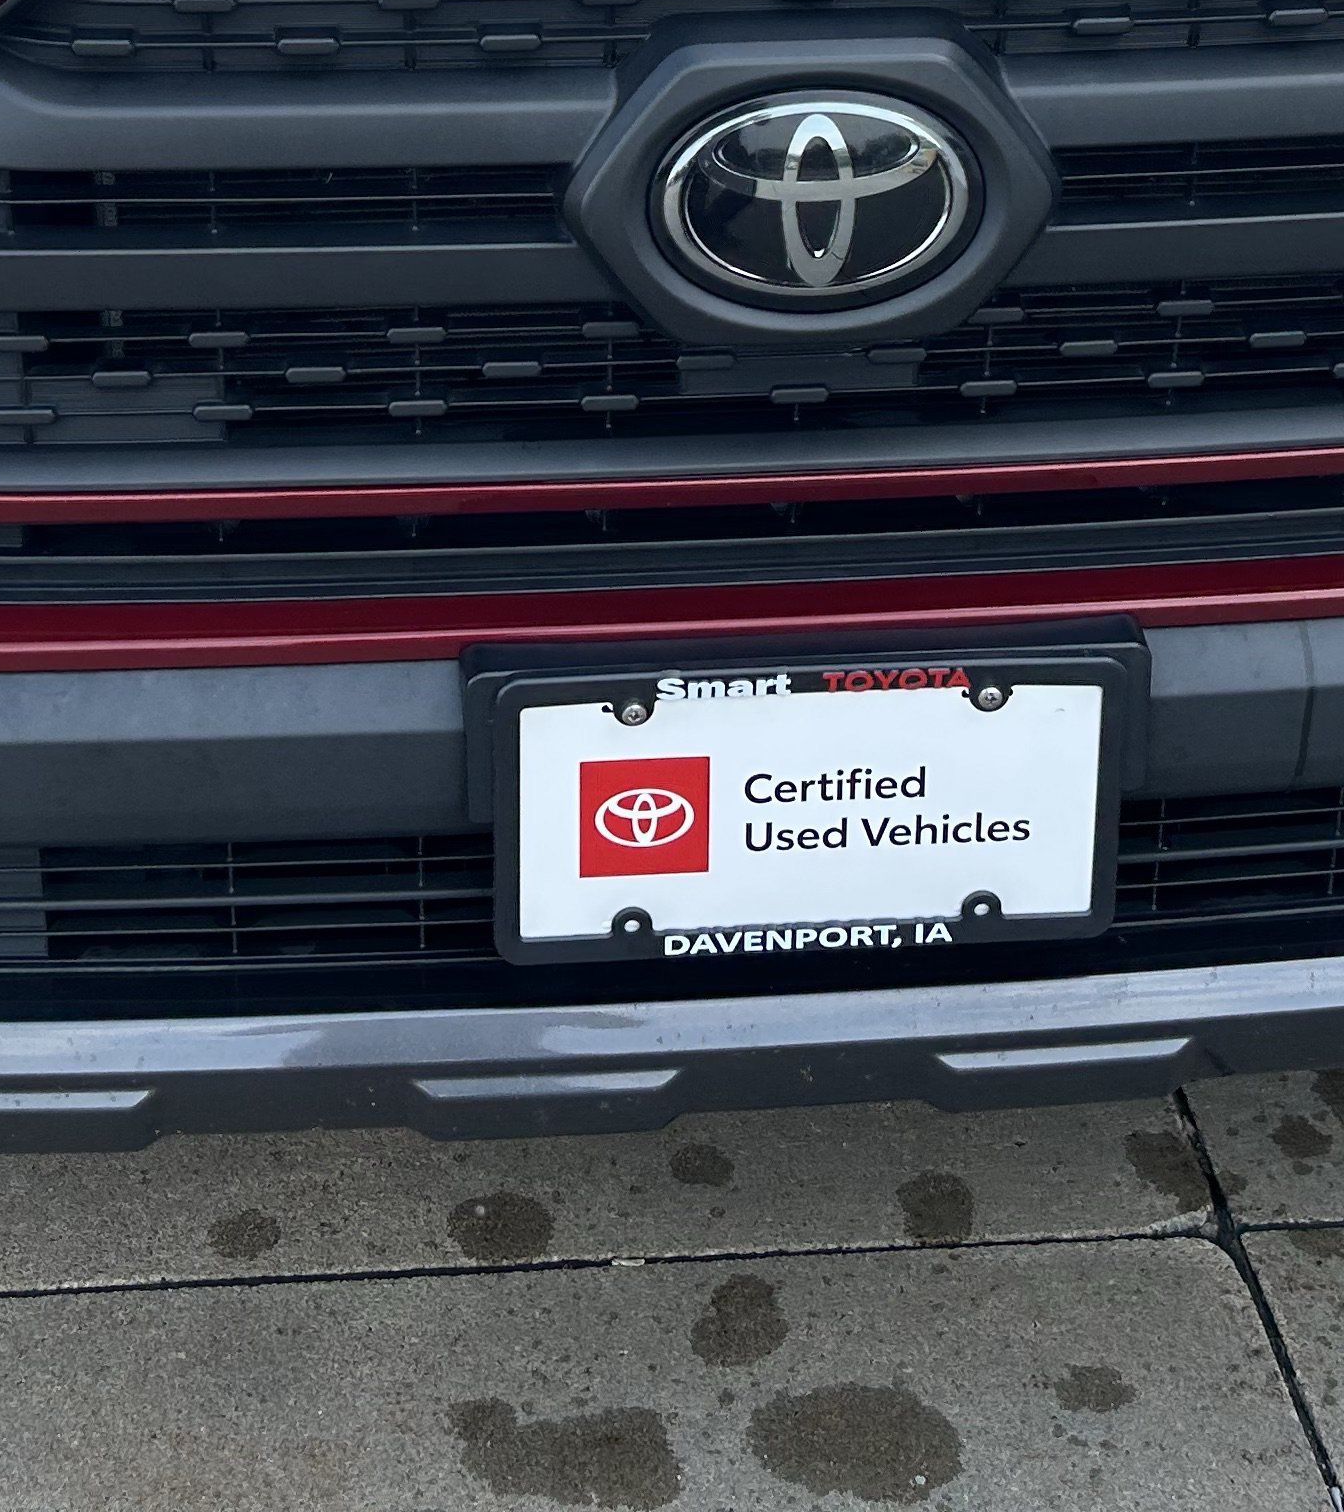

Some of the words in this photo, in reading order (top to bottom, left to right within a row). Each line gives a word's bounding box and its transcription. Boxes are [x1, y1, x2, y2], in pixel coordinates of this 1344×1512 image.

[656, 673, 792, 700] Smart
[823, 668, 971, 692] TOYOTA
[744, 766, 926, 804] Certified
[745, 817, 848, 852] Used
[861, 812, 1031, 847] Vehicles
[664, 924, 903, 956] DAVENPORT,
[915, 923, 953, 944] IA
